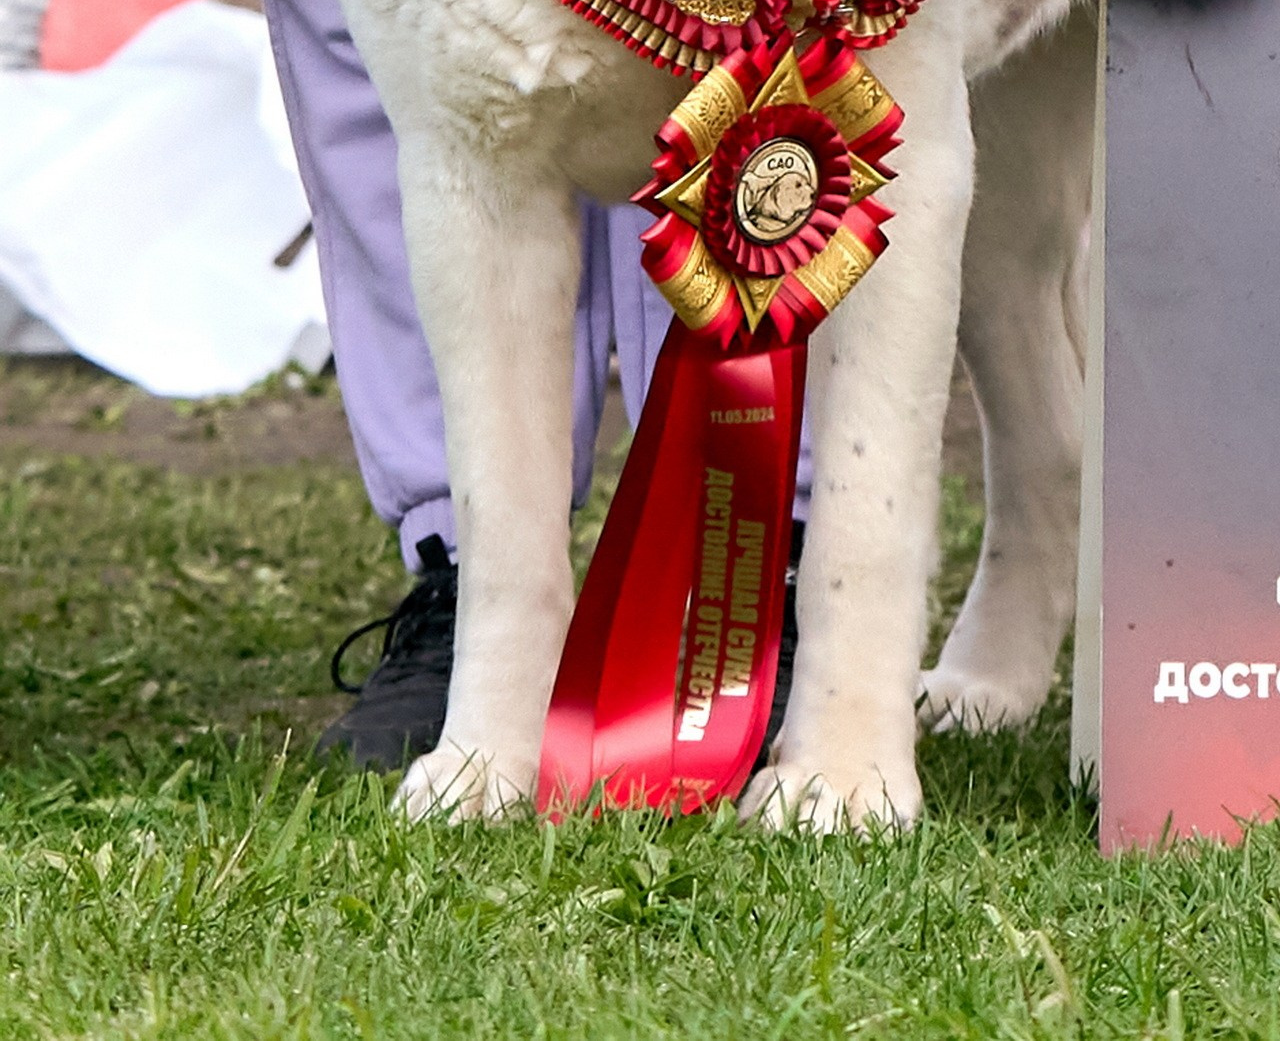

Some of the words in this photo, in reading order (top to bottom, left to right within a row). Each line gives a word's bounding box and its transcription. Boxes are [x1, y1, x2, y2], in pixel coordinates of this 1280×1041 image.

[767, 156, 795, 169] САО
[710, 405, 775, 425] 11.05.2024
[699, 467, 735, 601] ДОСТОЯНИЕ
[730, 520, 766, 623] ЛУЧШАЯ
[677, 605, 723, 742] ОТЕЧЕСТВА
[719, 628, 757, 697] СУКА
